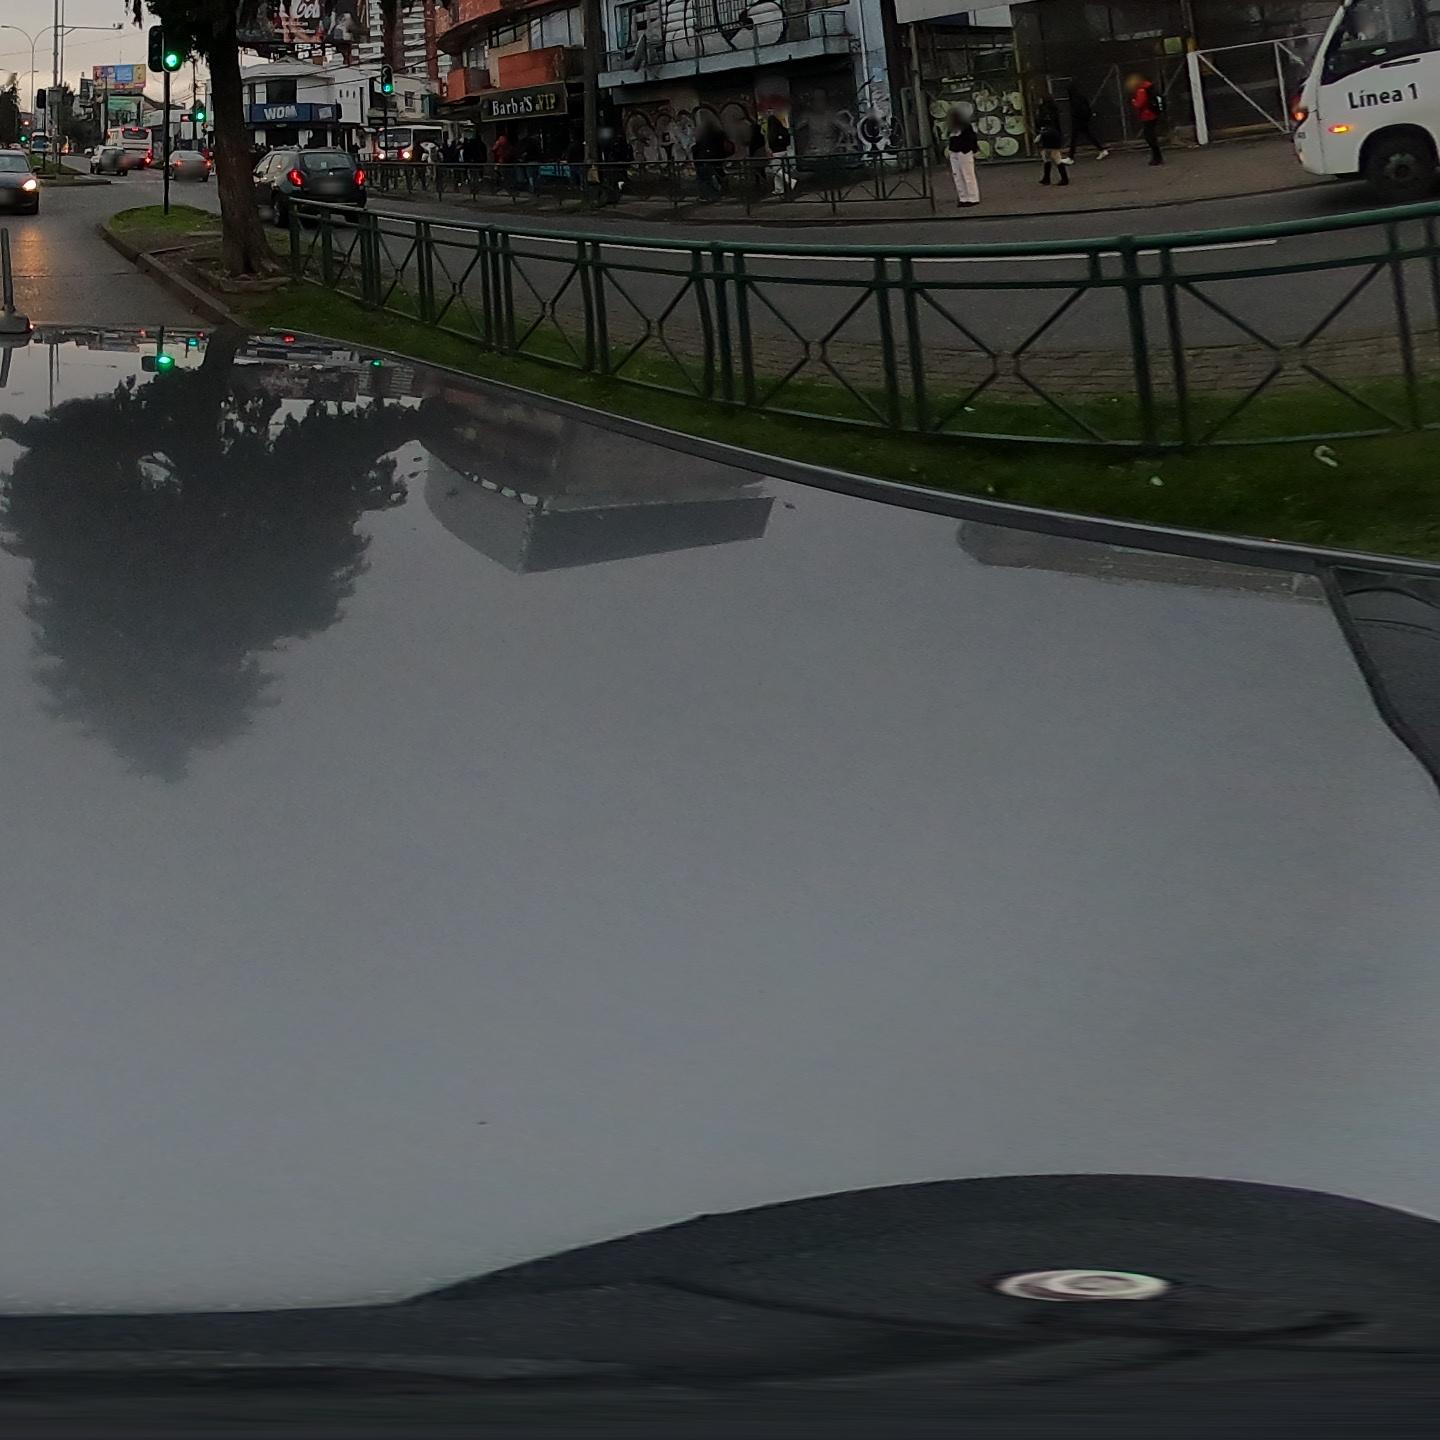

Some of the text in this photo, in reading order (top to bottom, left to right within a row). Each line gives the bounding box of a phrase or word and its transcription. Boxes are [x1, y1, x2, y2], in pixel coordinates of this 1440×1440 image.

[1347, 82, 1418, 109] Línea 1
[263, 105, 298, 120] WOM
